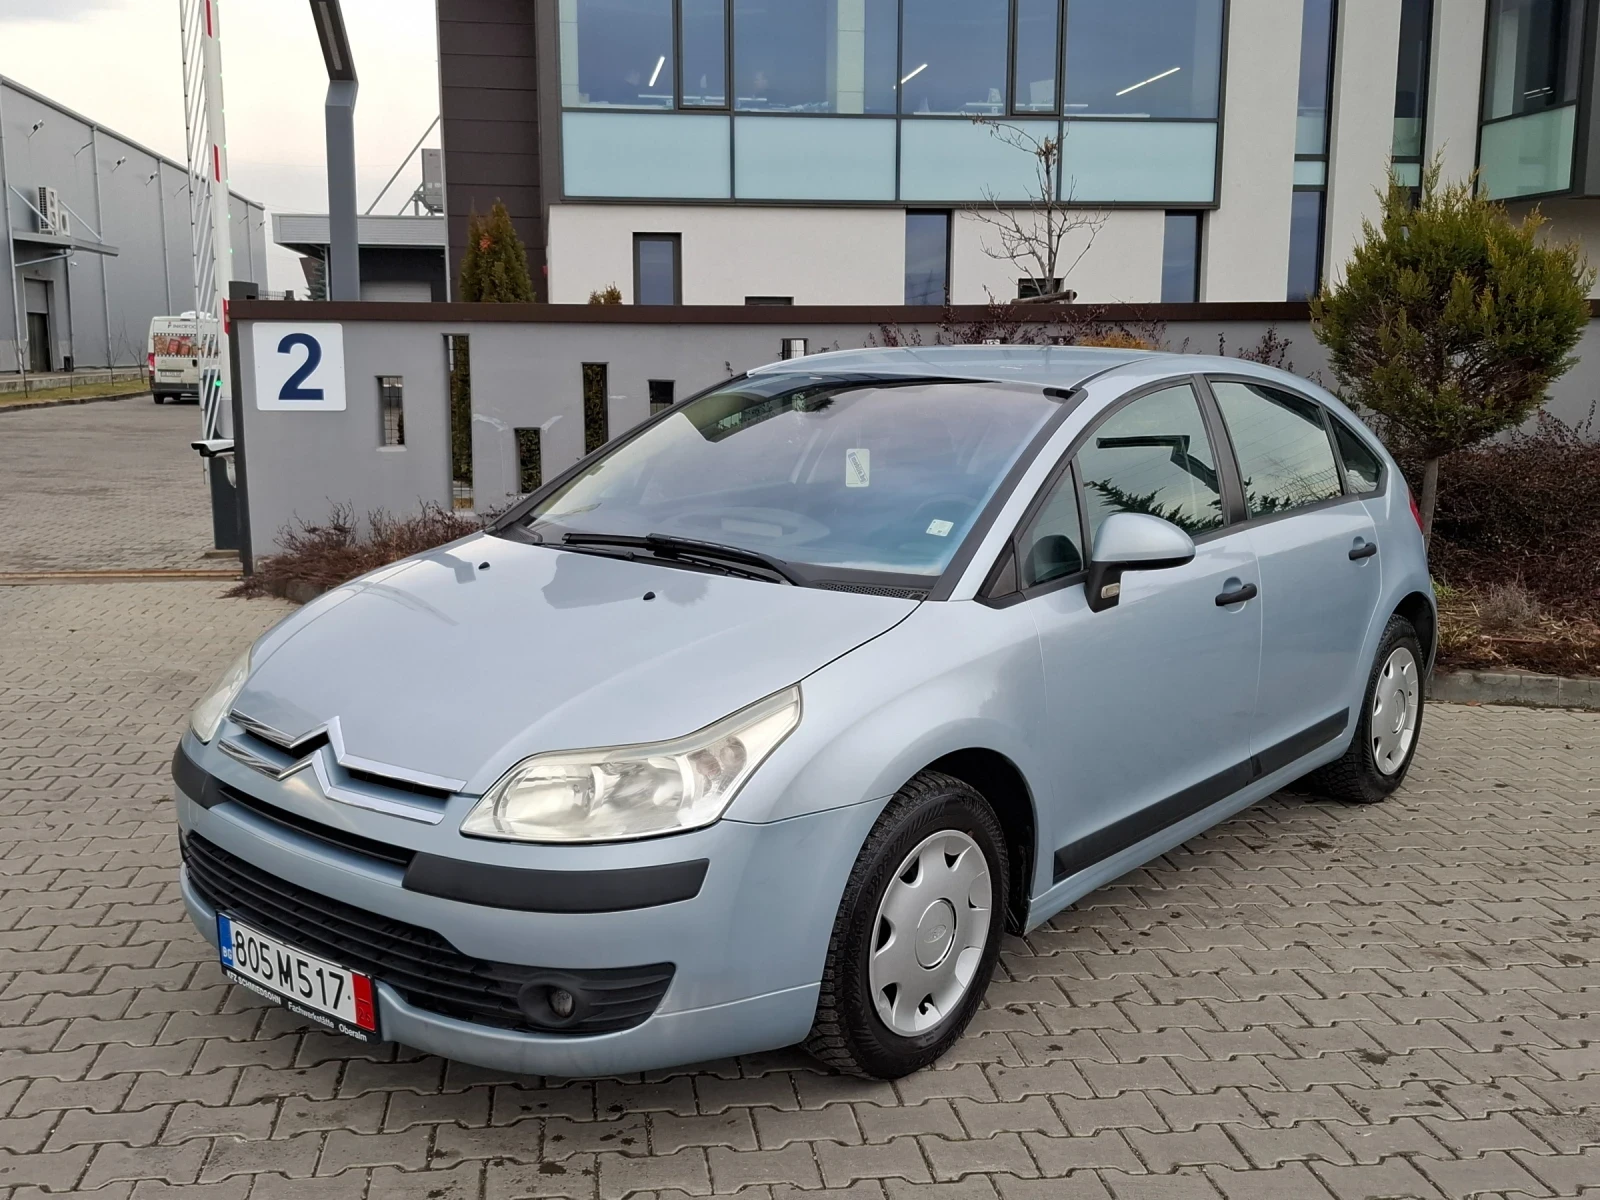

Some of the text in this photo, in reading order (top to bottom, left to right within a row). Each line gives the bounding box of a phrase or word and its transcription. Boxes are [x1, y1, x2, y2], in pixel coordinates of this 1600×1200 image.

[278, 333, 324, 400] 2
[222, 946, 233, 959] BG
[226, 970, 368, 1042] KFZ SCHMIEDSOHN Fachwerkstätte Oberalm
